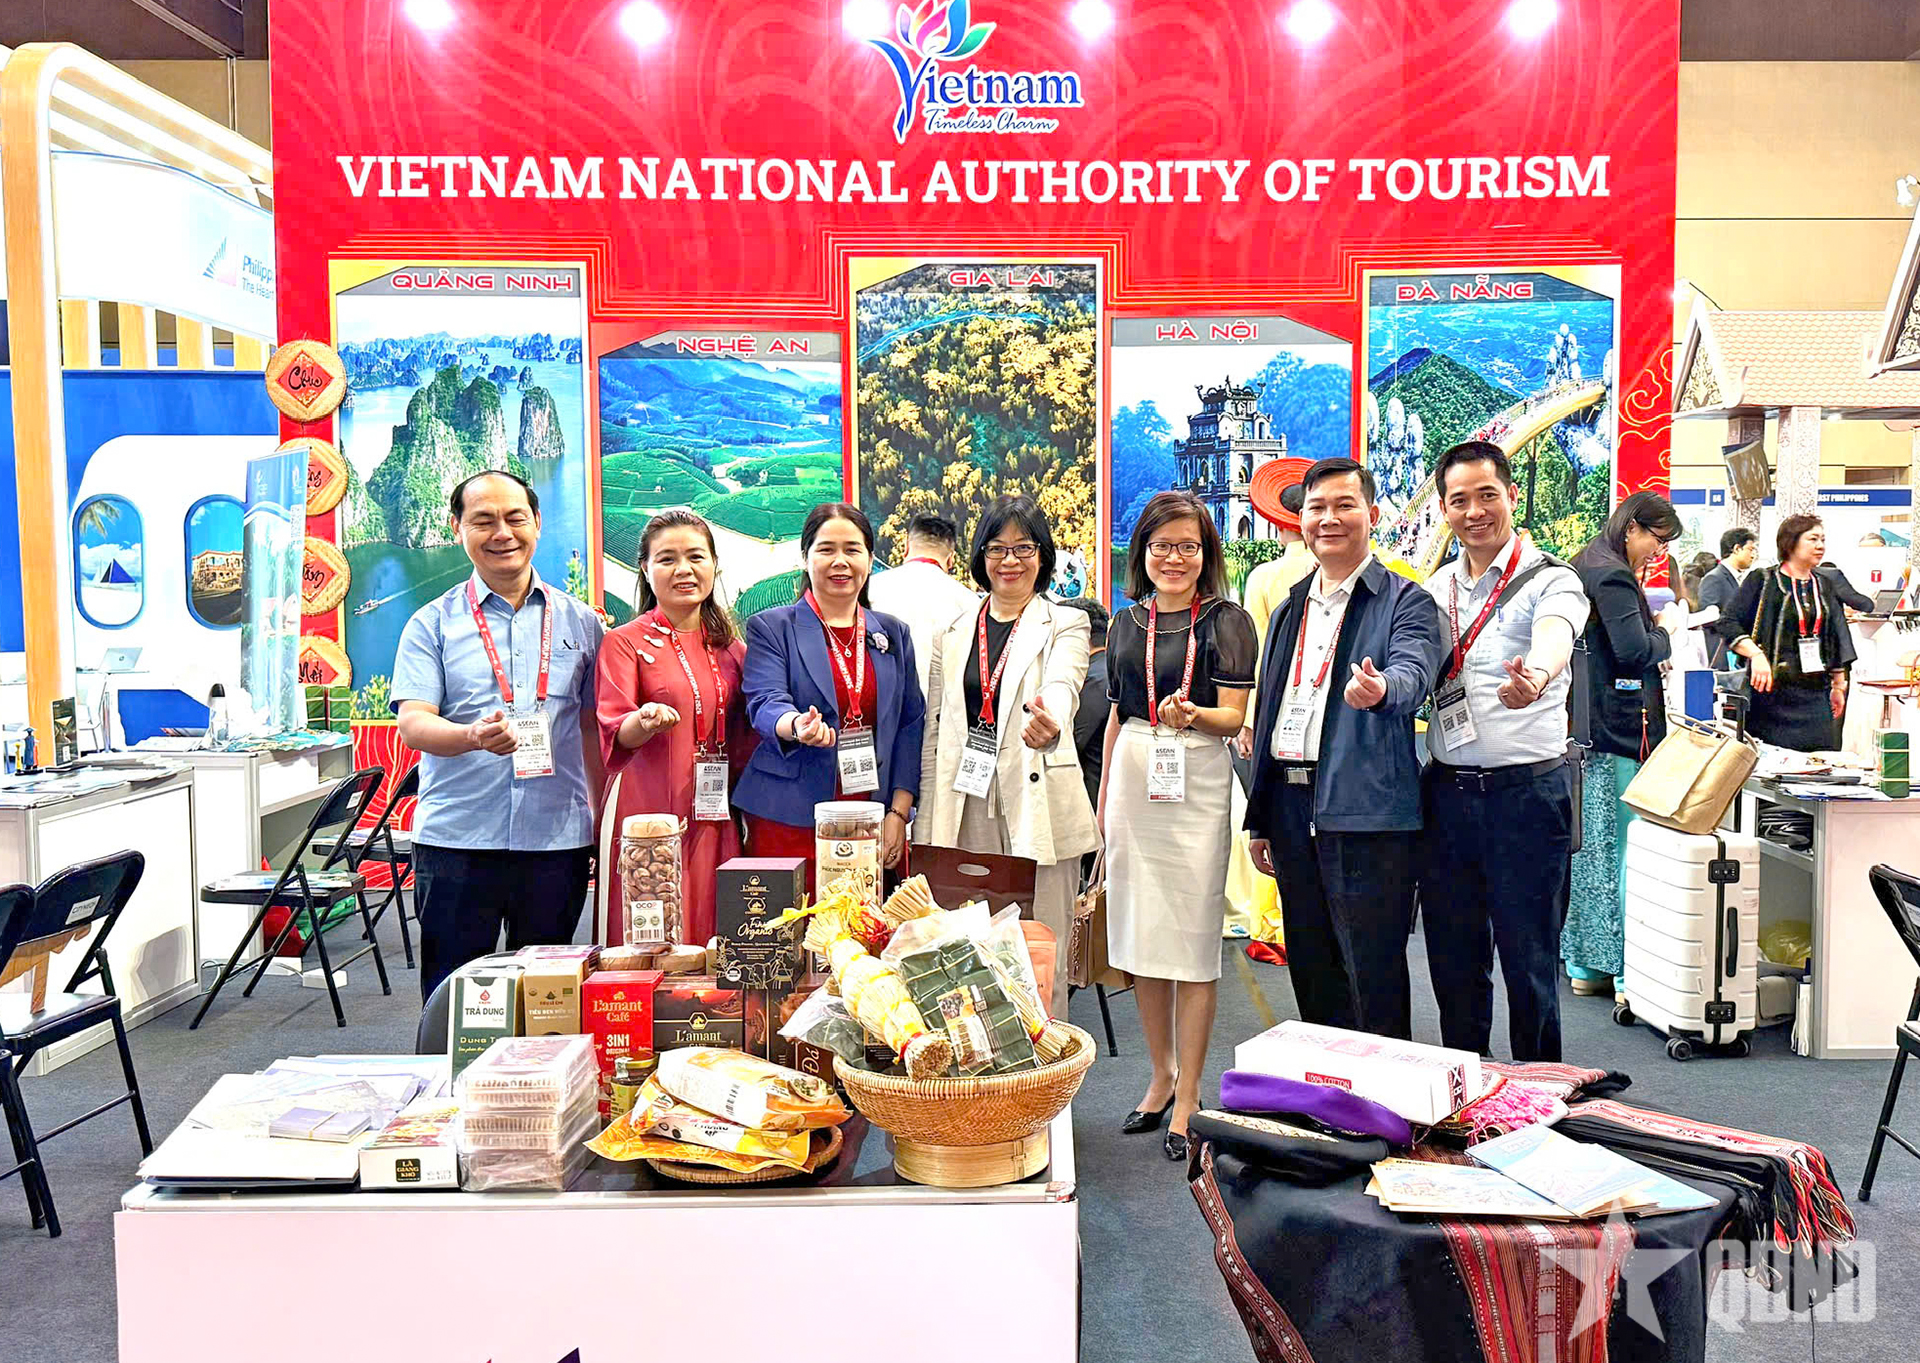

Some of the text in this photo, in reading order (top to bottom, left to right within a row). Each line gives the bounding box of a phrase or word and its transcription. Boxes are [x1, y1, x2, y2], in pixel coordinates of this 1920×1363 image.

[924, 107, 1056, 131] Timeless Charm
[336, 155, 1611, 204] VIETNAM NATIONAL AUTHORITY OF TOURISM
[243, 254, 274, 284] Philipp
[948, 271, 1054, 287] GIA LAI
[391, 270, 572, 290] QUẢNG NINH
[1397, 275, 1533, 300] ĐÀ NẴNG
[1156, 320, 1258, 344] HÀ NỘI
[677, 335, 810, 357] NGHỆ AN
[636, 902, 657, 910] OCOP
[593, 999, 643, 1013] L'amant
[606, 1011, 630, 1023] Café
[606, 1033, 630, 1048] 3IN1
[675, 1029, 722, 1042] L'amant
[801, 1046, 820, 1074] Đá
